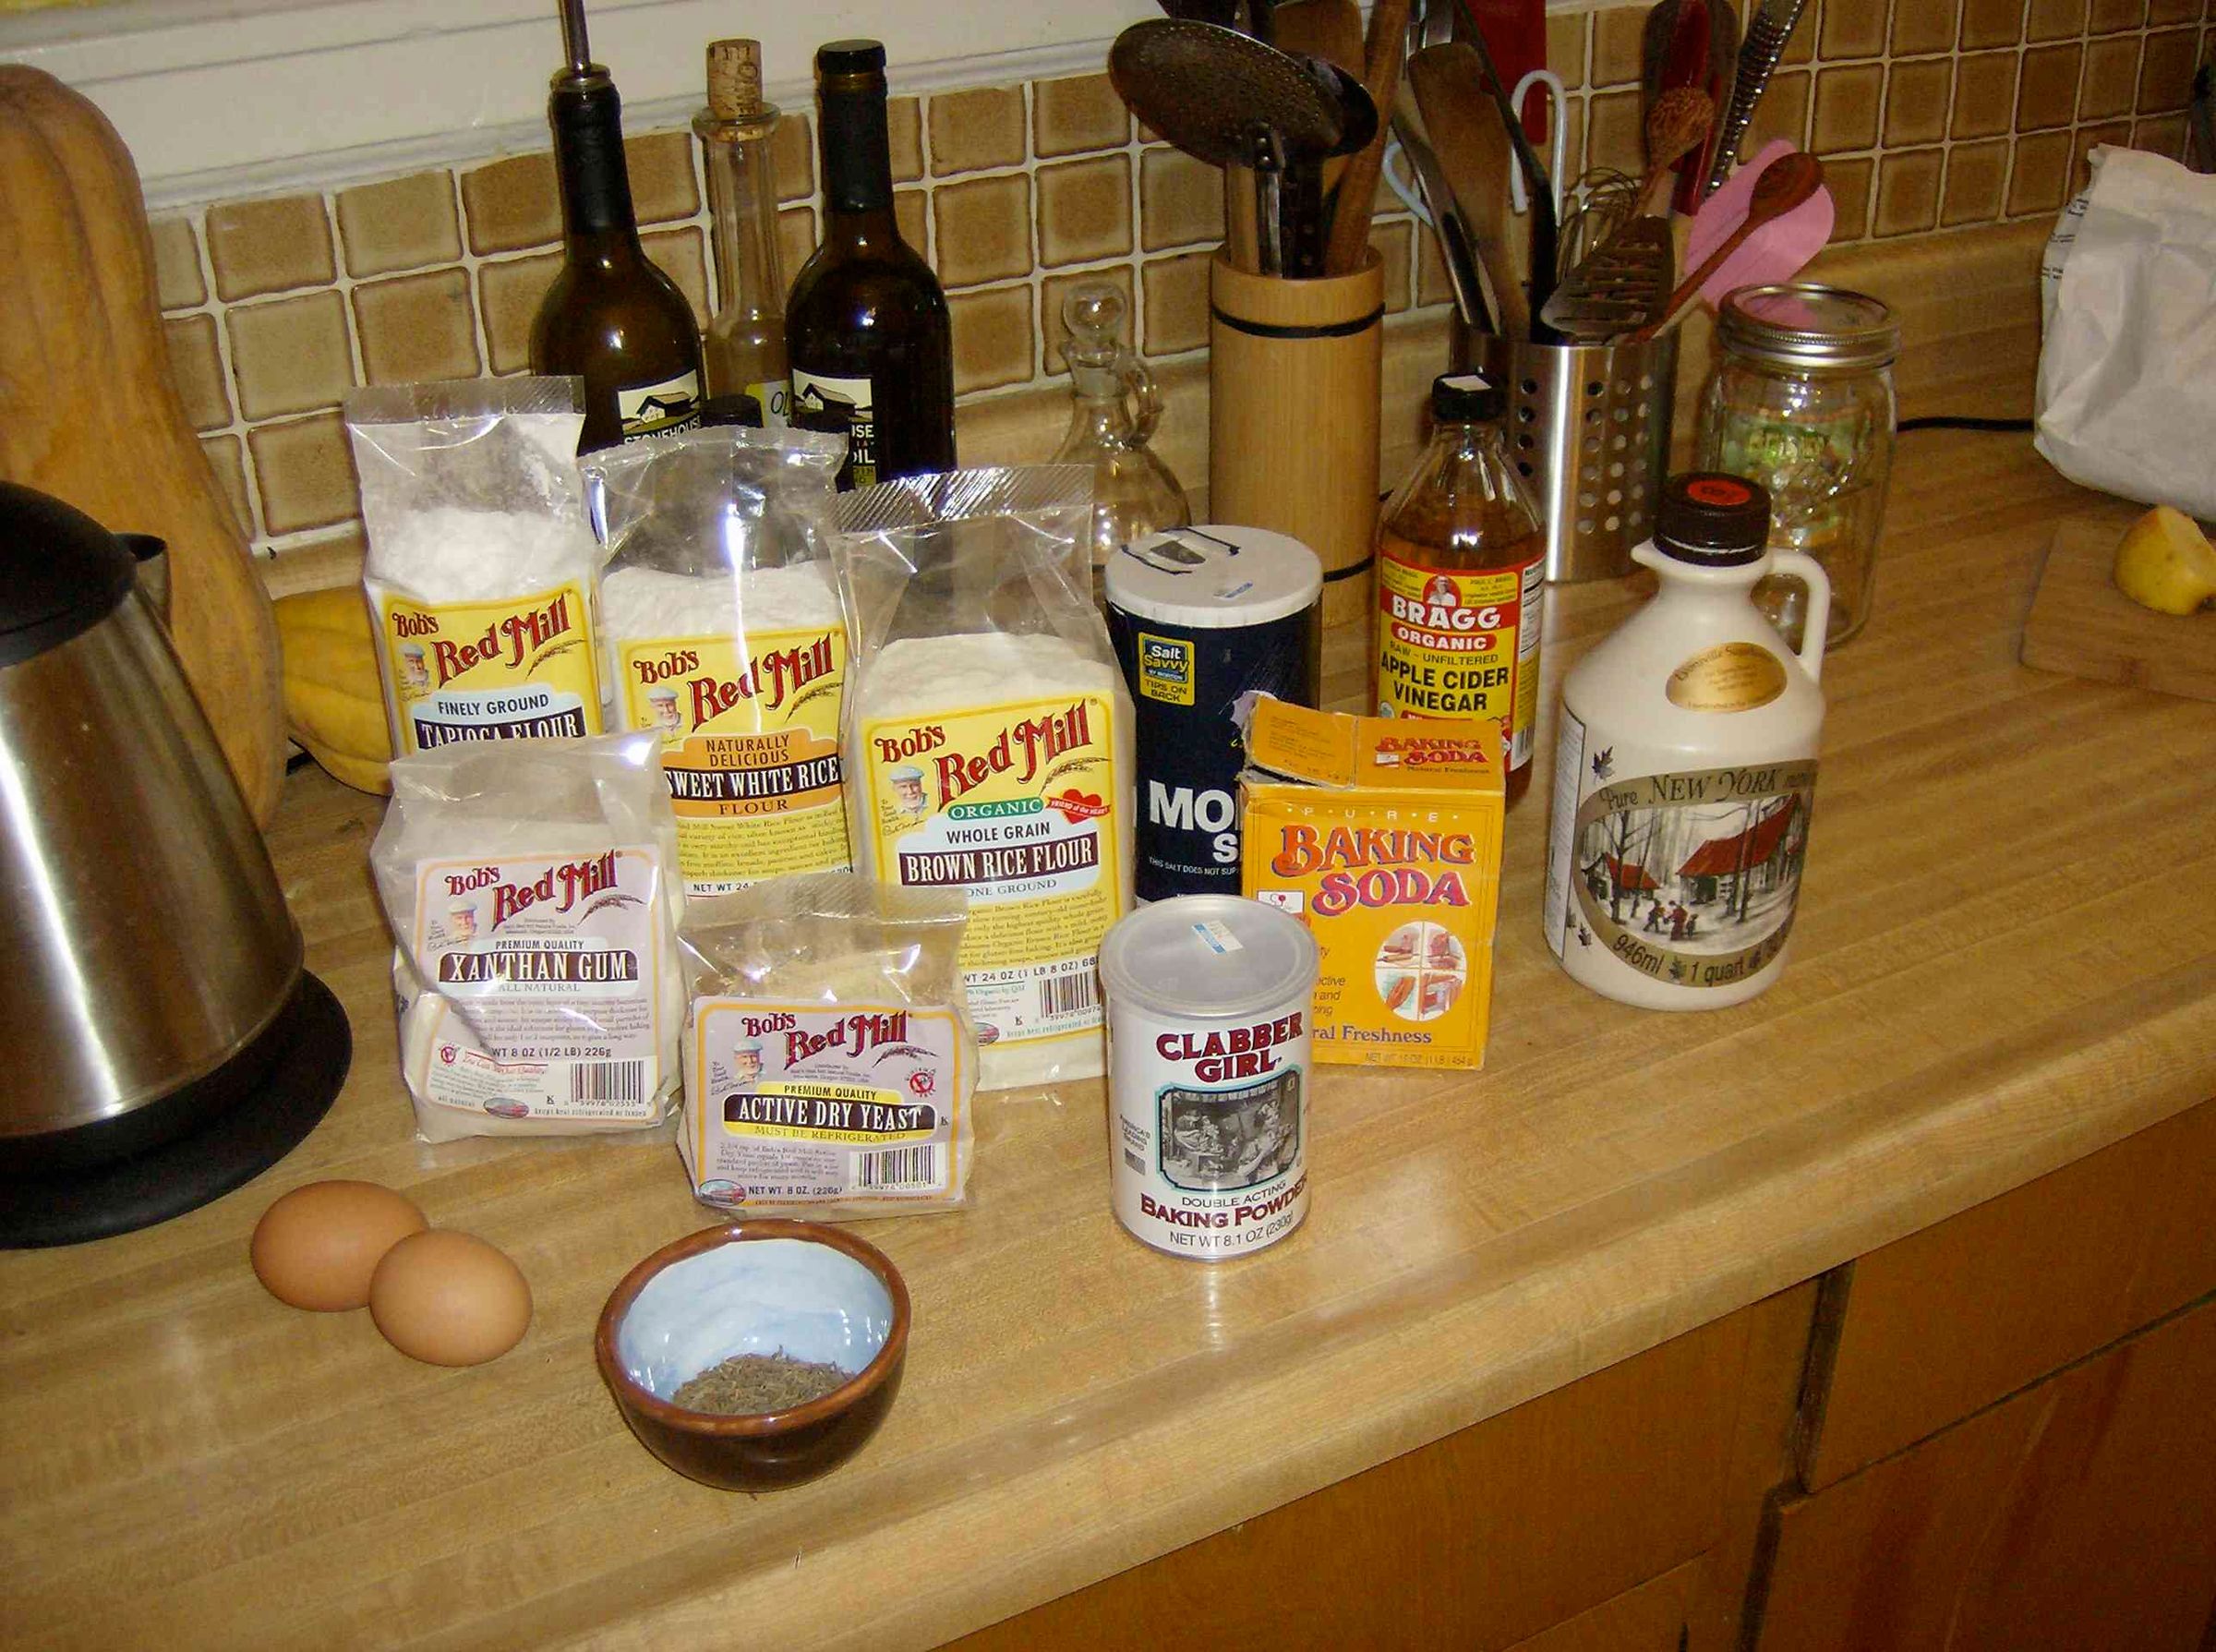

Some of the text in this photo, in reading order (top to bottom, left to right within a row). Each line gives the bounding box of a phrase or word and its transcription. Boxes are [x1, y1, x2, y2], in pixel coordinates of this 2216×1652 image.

[624, 415, 702, 444] SNEHOUS
[1392, 594, 1500, 630] BRAGG
[392, 612, 439, 637] Bob's
[430, 593, 572, 689] Red Mill
[1397, 627, 1487, 650] ORGANIC
[1144, 655, 1189, 673] Savvy
[1151, 645, 1181, 659] Salt
[1423, 654, 1499, 666] UNFILTERED
[633, 650, 700, 684] Bob's
[1381, 652, 1509, 691] APPLE CIDER
[687, 633, 835, 732] Red Mill
[1171, 686, 1187, 694] ON
[439, 693, 549, 716] FINELY GROUND
[1151, 689, 1181, 702] BACK
[1393, 681, 1488, 712] VINEGAR
[706, 734, 789, 753] NATURALLY
[874, 725, 945, 764] Bob's
[933, 698, 1093, 813] Red Mill
[710, 750, 789, 767] DELICIOUS
[1403, 751, 1488, 765] SODA
[729, 765, 794, 798] WHITE
[801, 756, 838, 790] RICE
[1599, 787, 1639, 811] Pure
[1648, 774, 1712, 804] NEW
[1716, 767, 1783, 802] YORK
[717, 799, 789, 815] FLOUR
[950, 799, 1041, 819] ORGANIC
[1150, 779, 1240, 833] MO
[946, 822, 1051, 844] WHOLE GRAIN
[907, 837, 1092, 882] BROWN RICE FLOUR
[1271, 824, 1476, 877] BAKING
[445, 866, 500, 897] Bob's
[1204, 867, 1220, 876] NOT
[1222, 866, 1239, 876] SUP
[491, 849, 619, 932] Red Mill
[693, 883, 712, 892] NET
[717, 883, 732, 892] WT
[997, 880, 1057, 895] GROUND
[1312, 868, 1471, 916] SODA
[496, 940, 584, 949] PREMIUM QUALITY
[450, 952, 628, 982] XANTHAN GUM
[982, 972, 996, 982] 24
[1001, 971, 1015, 981] OZ
[1034, 967, 1046, 976] LB
[1051, 965, 1057, 973] 8
[1062, 961, 1078, 972] OZ)
[1613, 934, 1744, 987] 946ml 1 quart
[499, 983, 581, 993] ALL NATURAL
[741, 1013, 796, 1037] Bob's
[1156, 1012, 1303, 1061] CLABBER
[1342, 1025, 1432, 1044] Freshness
[784, 1009, 909, 1070] Red Mill
[492, 1048, 507, 1058] WT
[512, 1048, 517, 1057] 8
[522, 1048, 536, 1057] OZ
[539, 1047, 560, 1058] (1/2
[564, 1047, 582, 1058] LB)
[1195, 1049, 1276, 1083] GIRL
[785, 1084, 876, 1101] PREMIUM QUALITY
[739, 1096, 921, 1131] ACTIVE DRY YEAST
[755, 1127, 906, 1143] MUST BE REFRIGERATED
[749, 1187, 765, 1195] NET
[1182, 1179, 1286, 1209] DOUBLE ACTING
[1140, 1193, 1229, 1229] BAKING
[1170, 1231, 1197, 1248] NET
[1199, 1233, 1221, 1248] WT
[1223, 1230, 1241, 1247] 8.1
[1246, 1226, 1264, 1243] OZ
